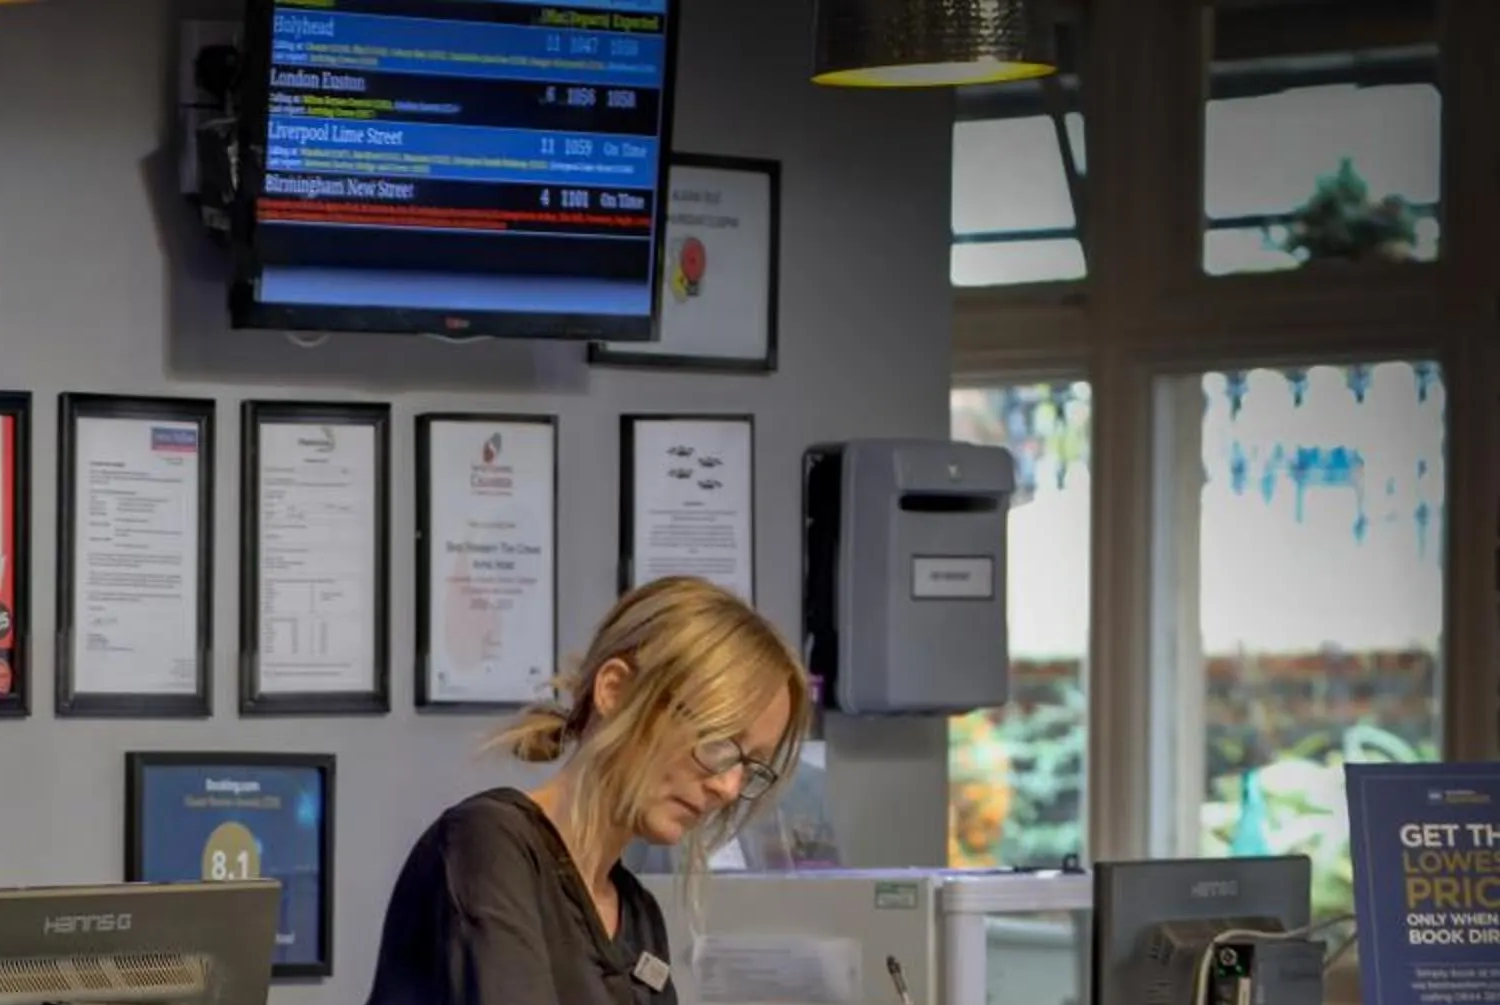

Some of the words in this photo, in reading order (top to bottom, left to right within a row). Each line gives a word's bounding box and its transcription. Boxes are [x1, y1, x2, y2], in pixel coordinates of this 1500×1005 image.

[274, 15, 335, 38] Holyhead
[270, 67, 319, 88] London
[321, 71, 366, 92] Euston
[269, 120, 329, 144] Liverpool
[331, 125, 365, 143] Lime
[367, 127, 403, 145] Street
[603, 143, 619, 156] On
[621, 144, 647, 158] Time
[265, 173, 344, 198] Birmingham
[347, 178, 377, 196] New
[378, 180, 414, 198] Street
[540, 188, 550, 206] 4
[600, 192, 617, 208] On
[618, 193, 645, 209] Time
[1400, 823, 1460, 848] GET
[211, 850, 250, 881] 8.1
[1406, 912, 1447, 926] ONLY
[1451, 913, 1499, 926] WHEN
[1409, 929, 1465, 945] BOOK
